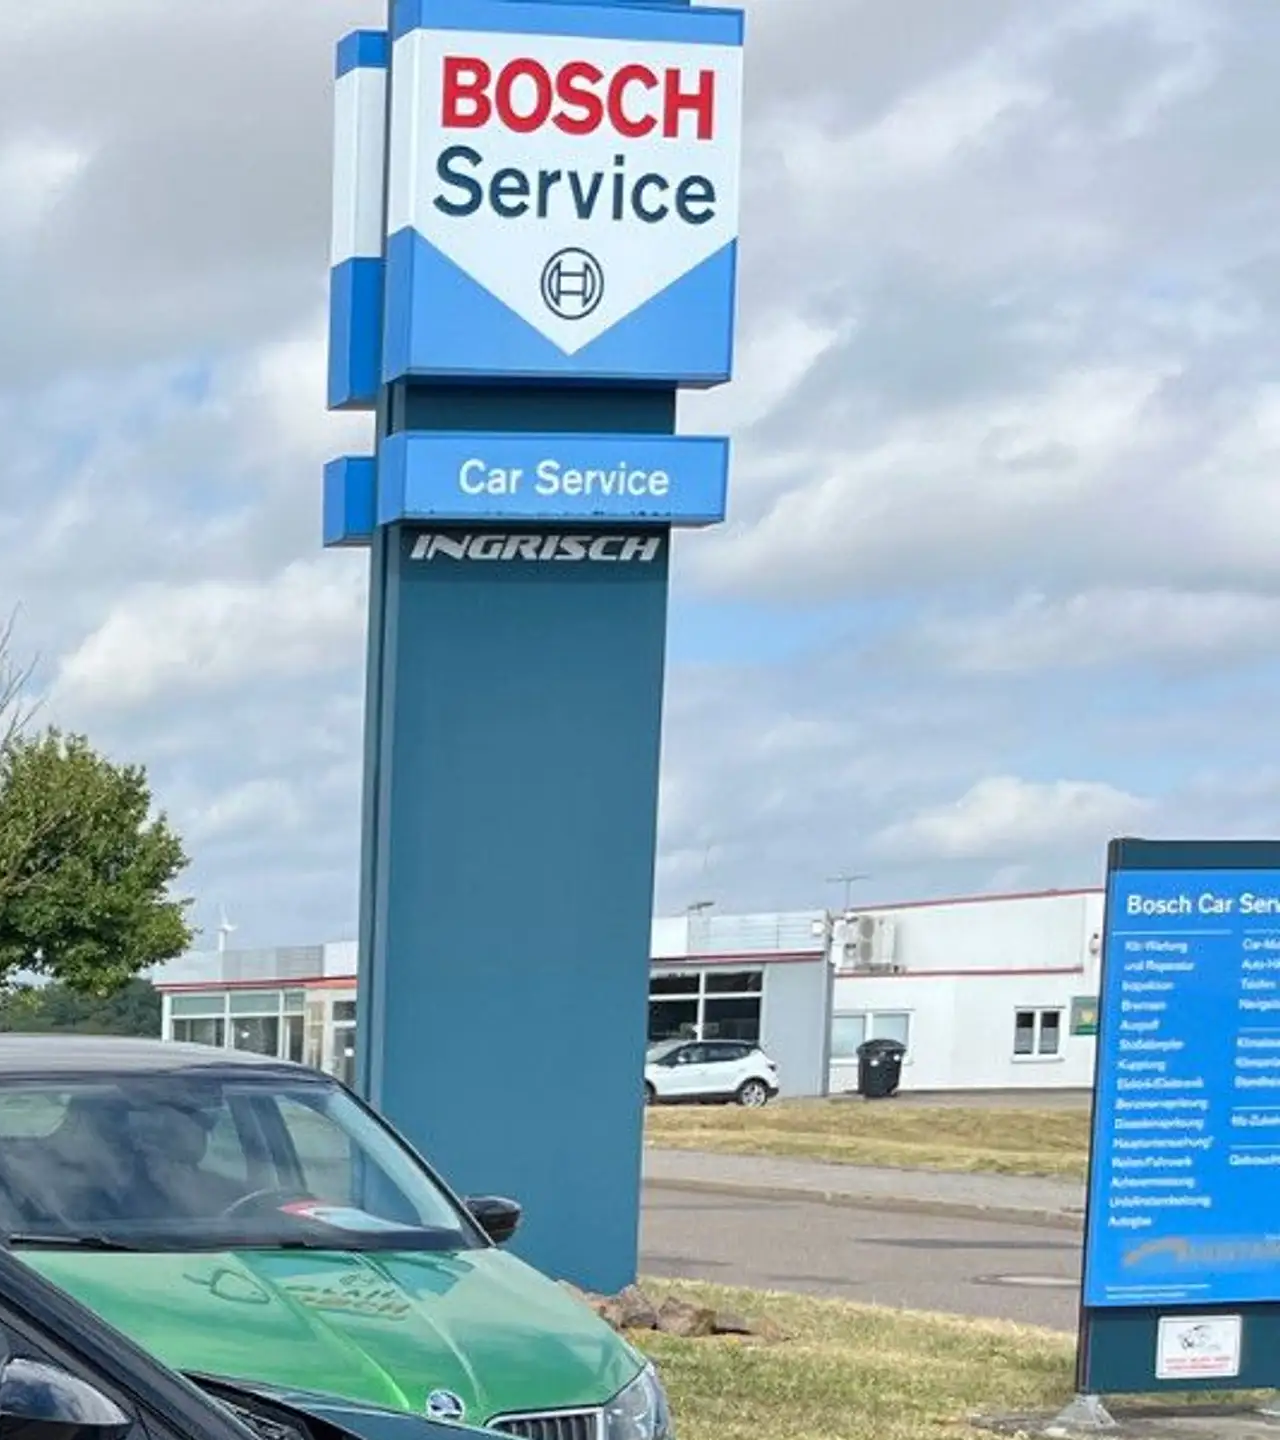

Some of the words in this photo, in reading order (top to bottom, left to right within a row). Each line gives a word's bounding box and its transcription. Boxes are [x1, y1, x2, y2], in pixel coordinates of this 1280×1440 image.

[441, 55, 714, 140] BOSCH
[433, 144, 717, 225] Service
[459, 459, 523, 495] Car
[535, 459, 669, 496] Service
[410, 534, 661, 563] INGRISCH
[1127, 894, 1191, 915] Bosch
[1198, 893, 1232, 914] Car
